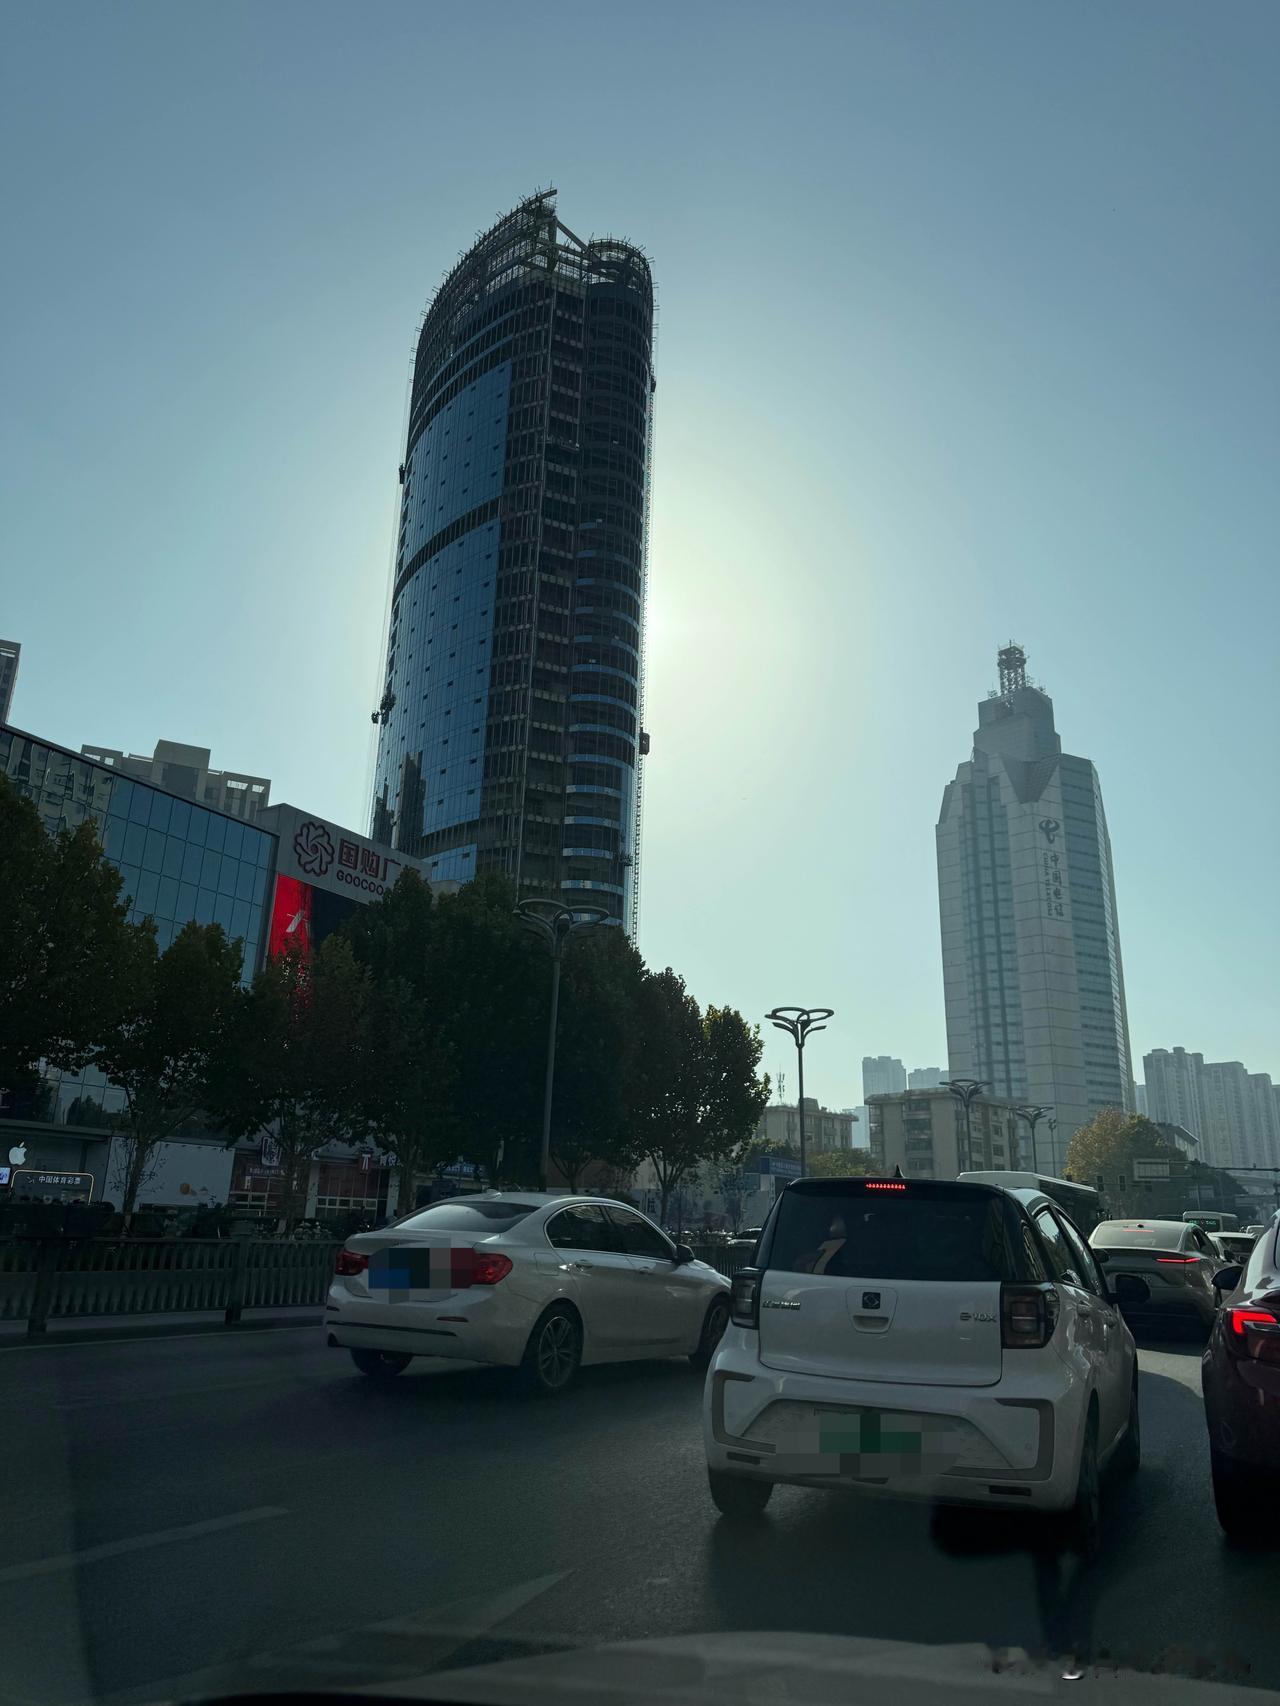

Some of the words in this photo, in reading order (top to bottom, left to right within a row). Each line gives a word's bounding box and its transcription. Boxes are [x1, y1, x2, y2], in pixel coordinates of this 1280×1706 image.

[339, 838, 420, 882] 国购广
[1050, 852, 1064, 917] 中国电信
[38, 1175, 81, 1185] 中国体育彩票
